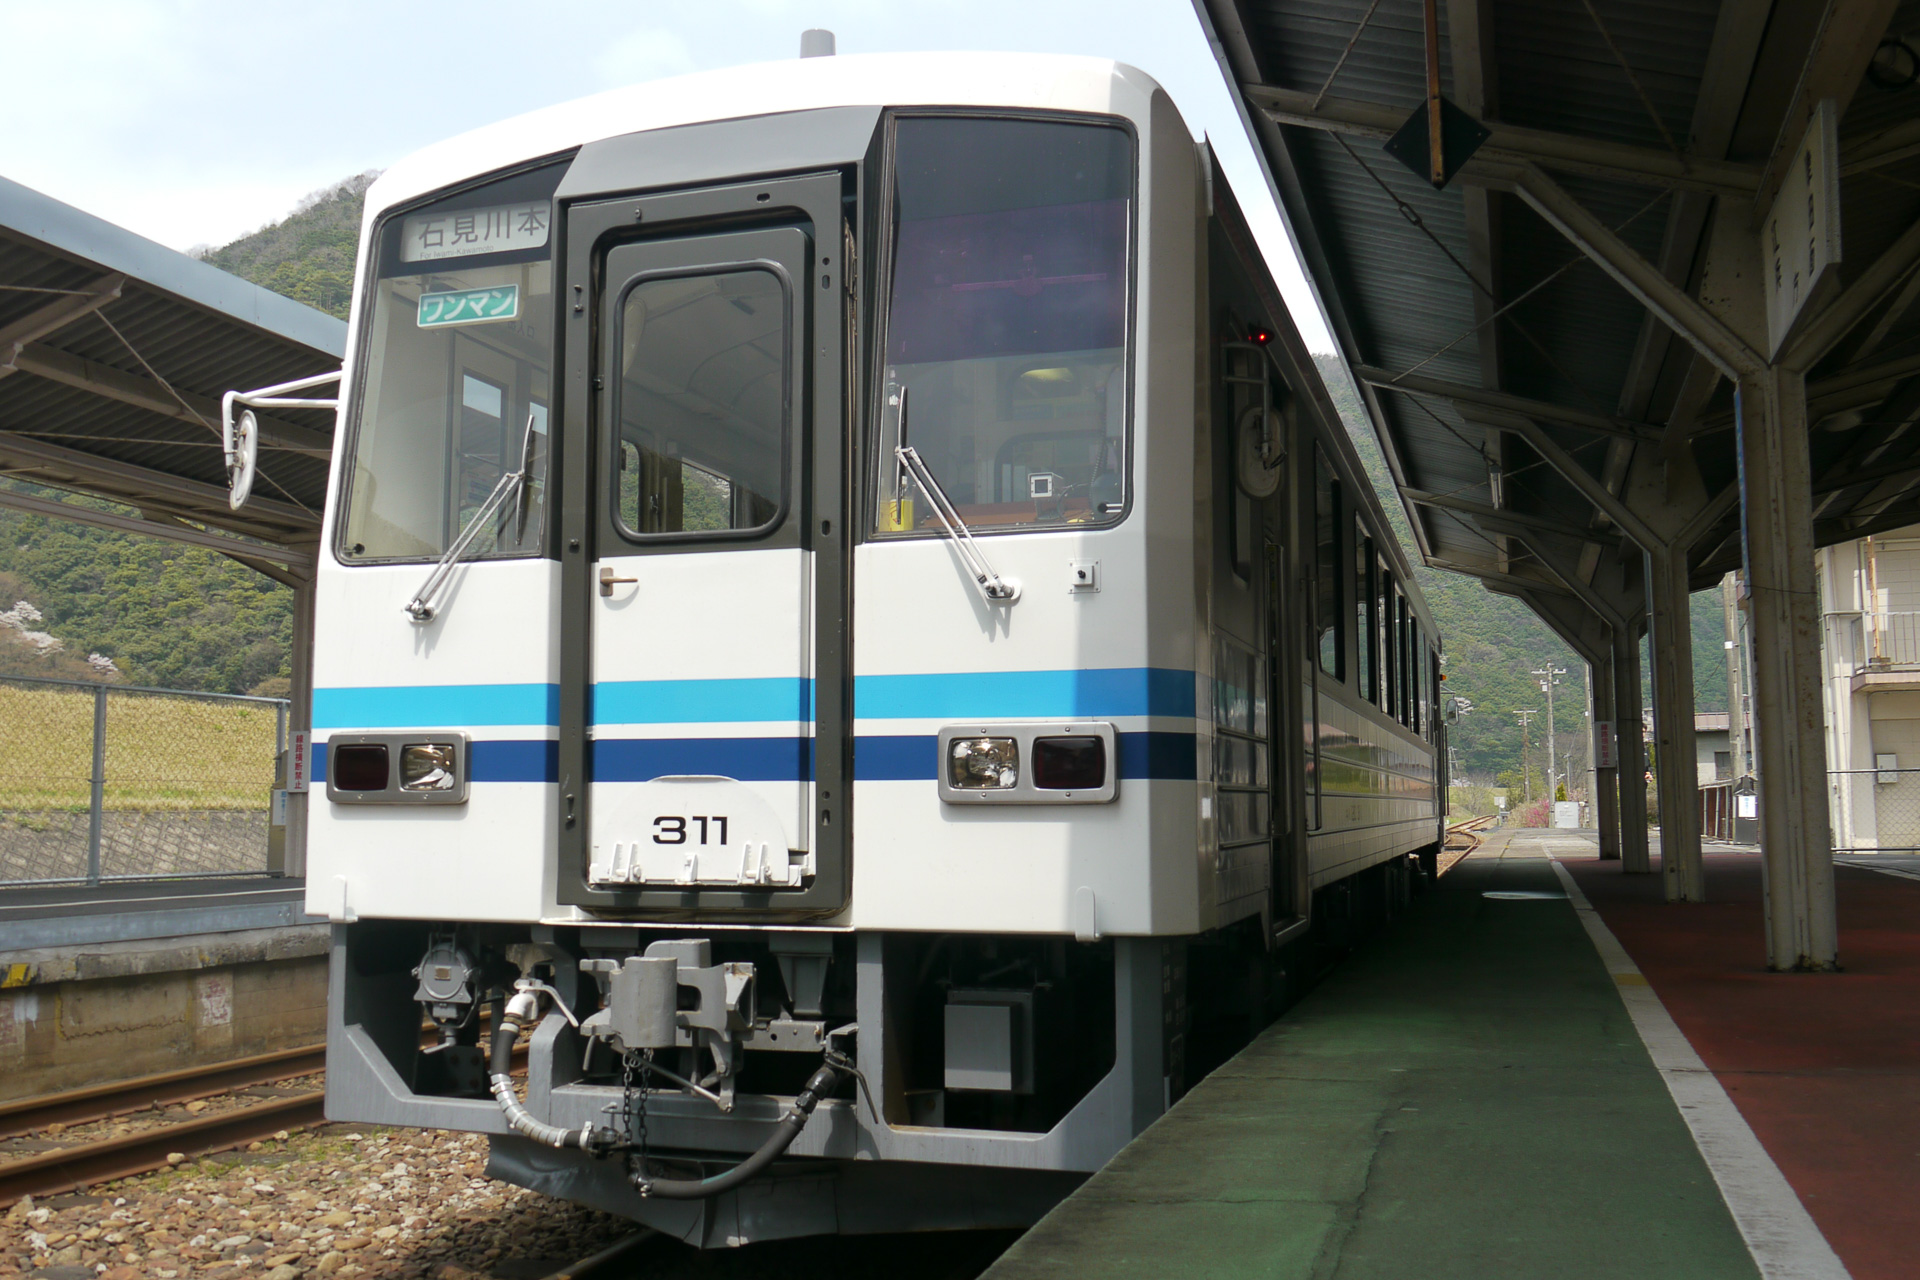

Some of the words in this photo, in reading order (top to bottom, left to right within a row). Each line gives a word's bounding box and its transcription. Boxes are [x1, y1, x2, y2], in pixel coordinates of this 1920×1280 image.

[418, 206, 546, 248] 石見川本
[423, 291, 513, 322] ワンマン
[652, 816, 728, 845] 311
